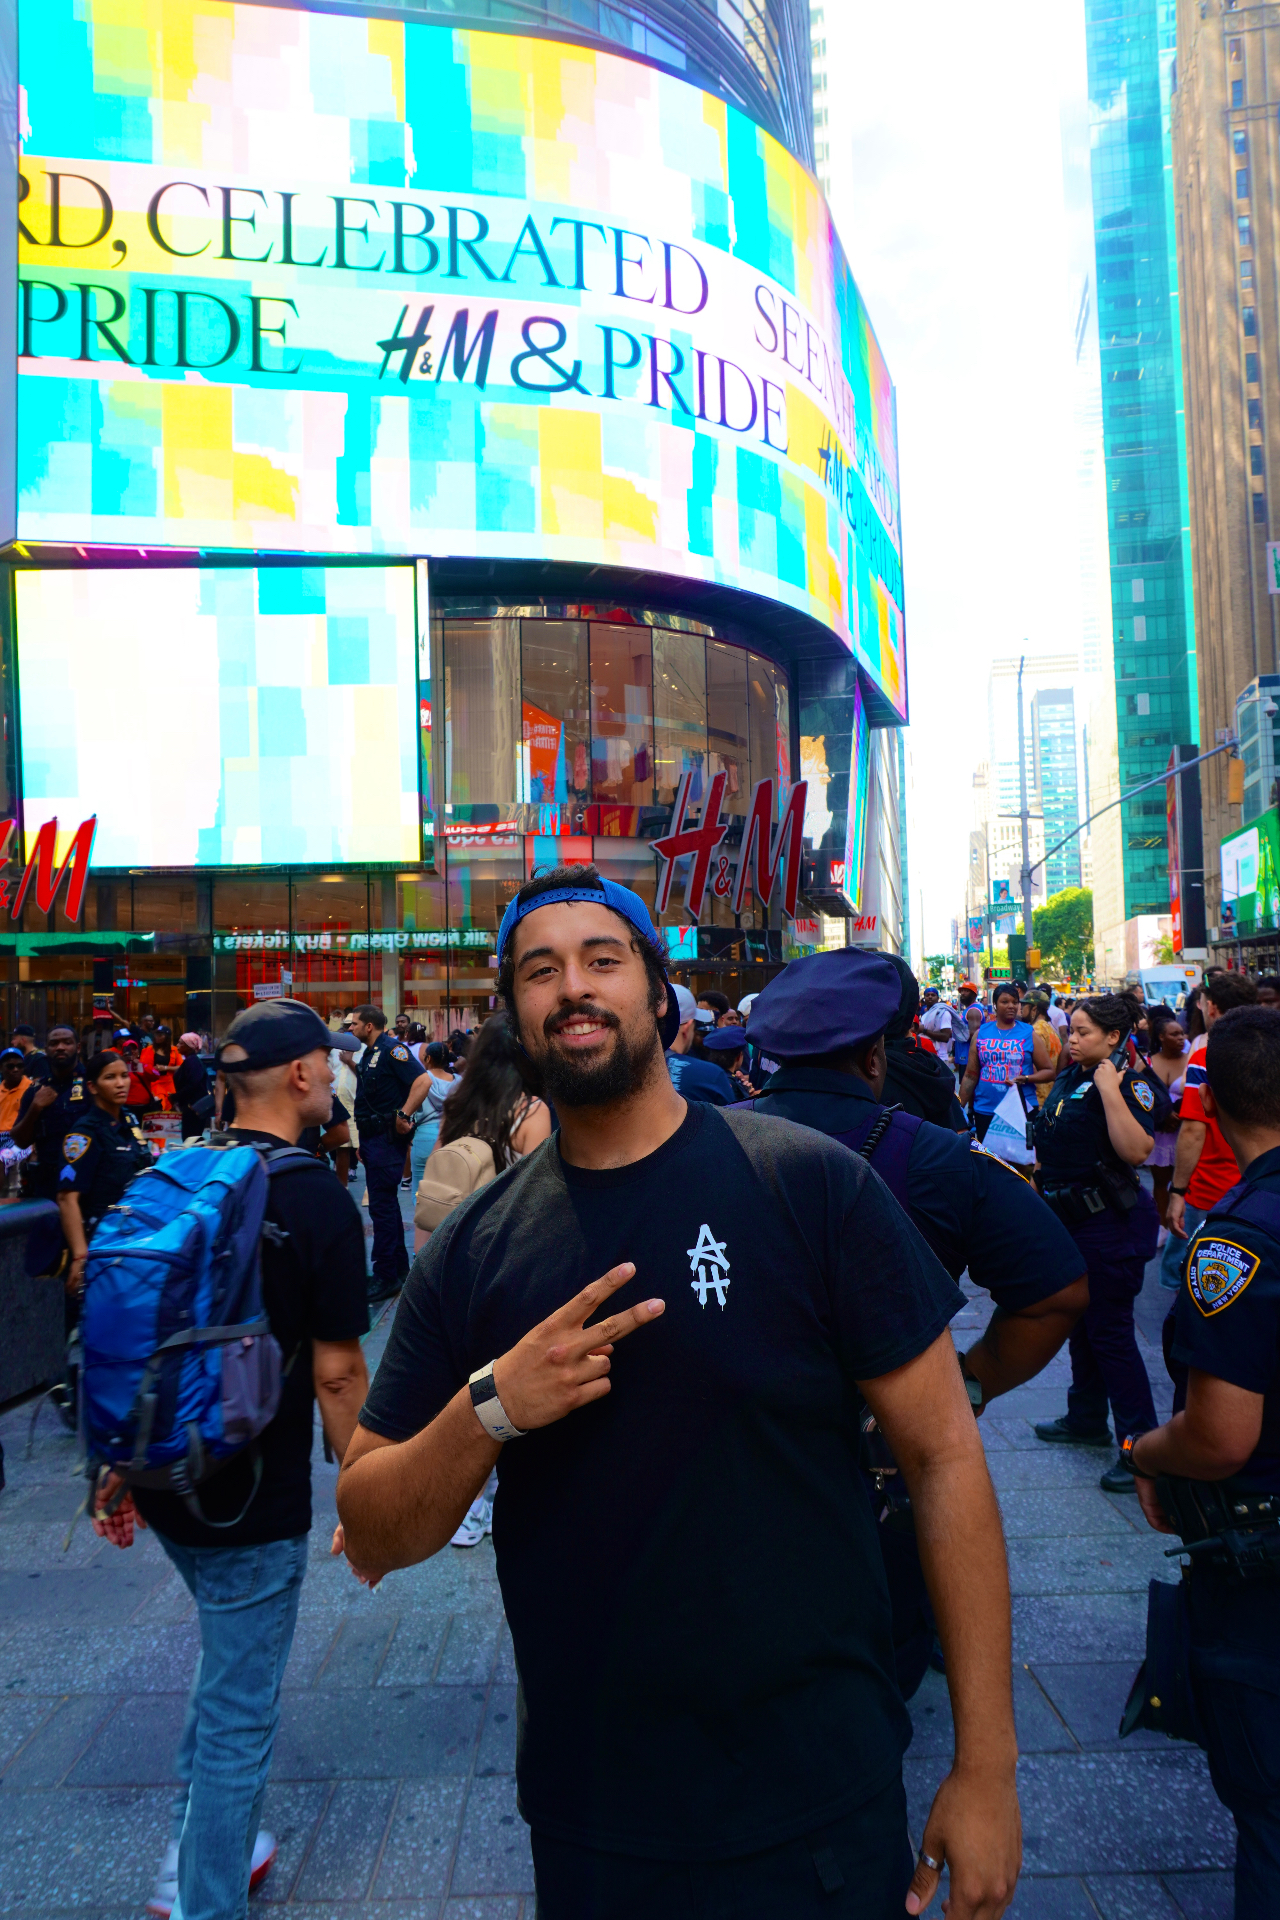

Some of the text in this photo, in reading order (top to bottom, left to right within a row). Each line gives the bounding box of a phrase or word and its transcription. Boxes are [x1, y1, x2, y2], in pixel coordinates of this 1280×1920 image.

[147, 181, 709, 315] CELEBRATED
[18, 279, 302, 375] PRIDE
[376, 304, 499, 391] H&M
[648, 769, 809, 920] H&M
[853, 915, 877, 931] H&M
[989, 904, 1021, 913] Broadway
[1196, 1249, 1251, 1273] DEPARTMENT
[1209, 1242, 1242, 1259] POLICE
[1190, 1266, 1202, 1300] CITY OF
[1211, 1294, 1229, 1310] NEW
[1227, 1276, 1248, 1296] YORK
